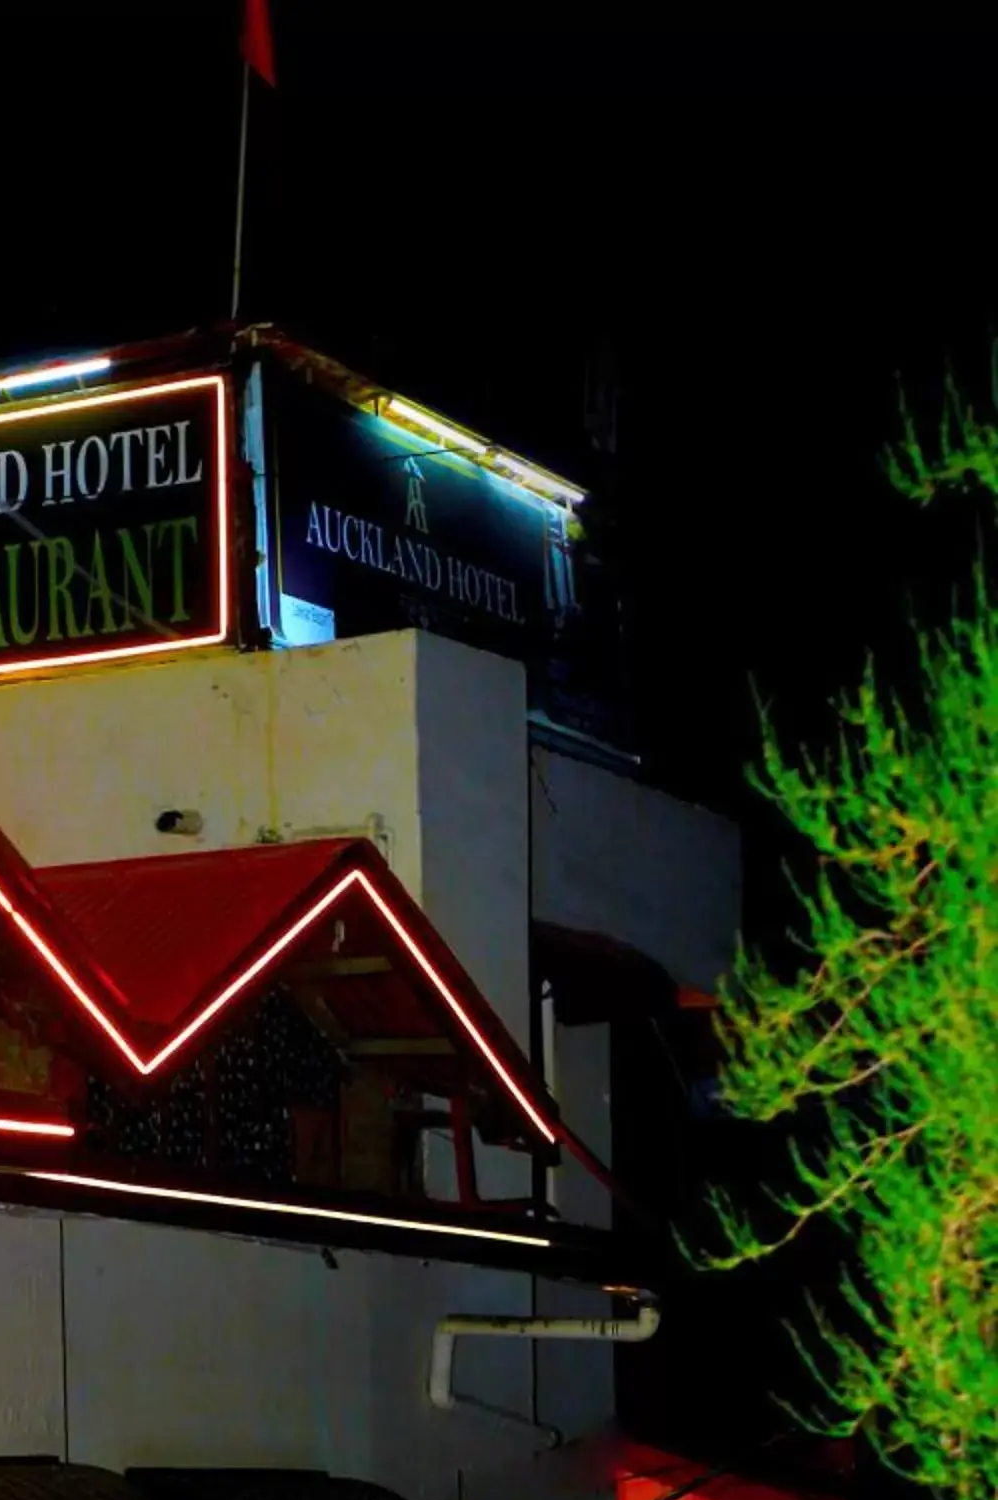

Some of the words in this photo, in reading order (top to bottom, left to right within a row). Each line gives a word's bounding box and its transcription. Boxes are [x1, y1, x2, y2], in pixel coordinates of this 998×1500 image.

[41, 419, 203, 507] HOTEL
[306, 501, 442, 591] AUCKLAND
[447, 556, 526, 625] HOTEL
